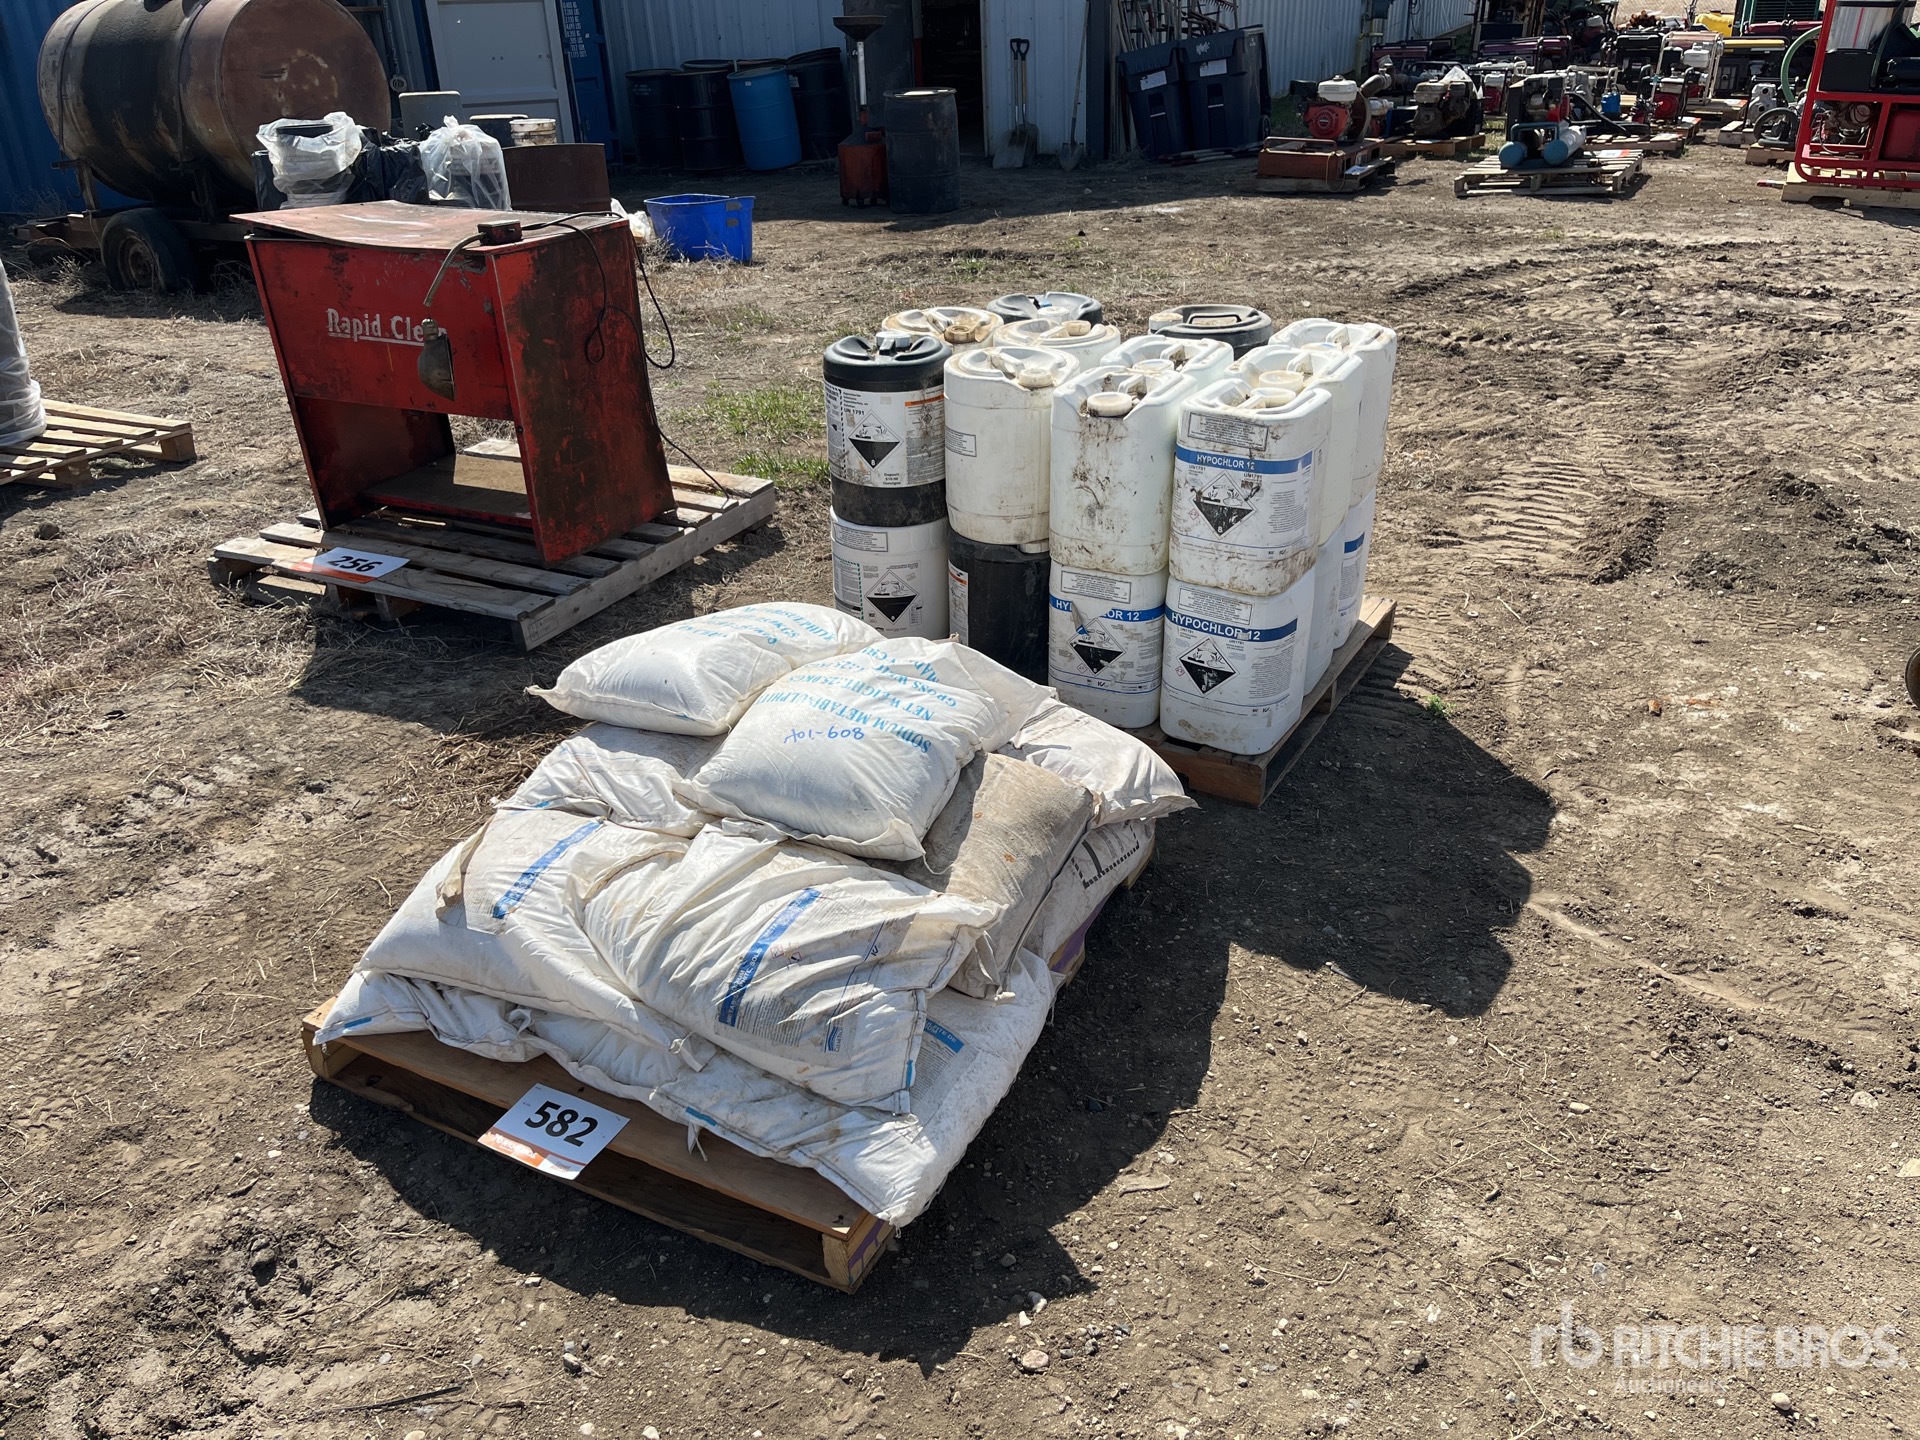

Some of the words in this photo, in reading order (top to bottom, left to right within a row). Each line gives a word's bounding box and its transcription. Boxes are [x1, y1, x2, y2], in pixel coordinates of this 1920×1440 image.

[327, 307, 382, 343] Rapid
[1196, 453, 1244, 469] HYPOCHLOR
[1246, 461, 1255, 471] 12
[327, 555, 383, 572] 256
[1127, 612, 1140, 621] 12
[1248, 630, 1261, 641] 12
[902, 702, 935, 721] NET
[872, 717, 932, 754] SODIUM
[524, 1100, 599, 1148] 582
